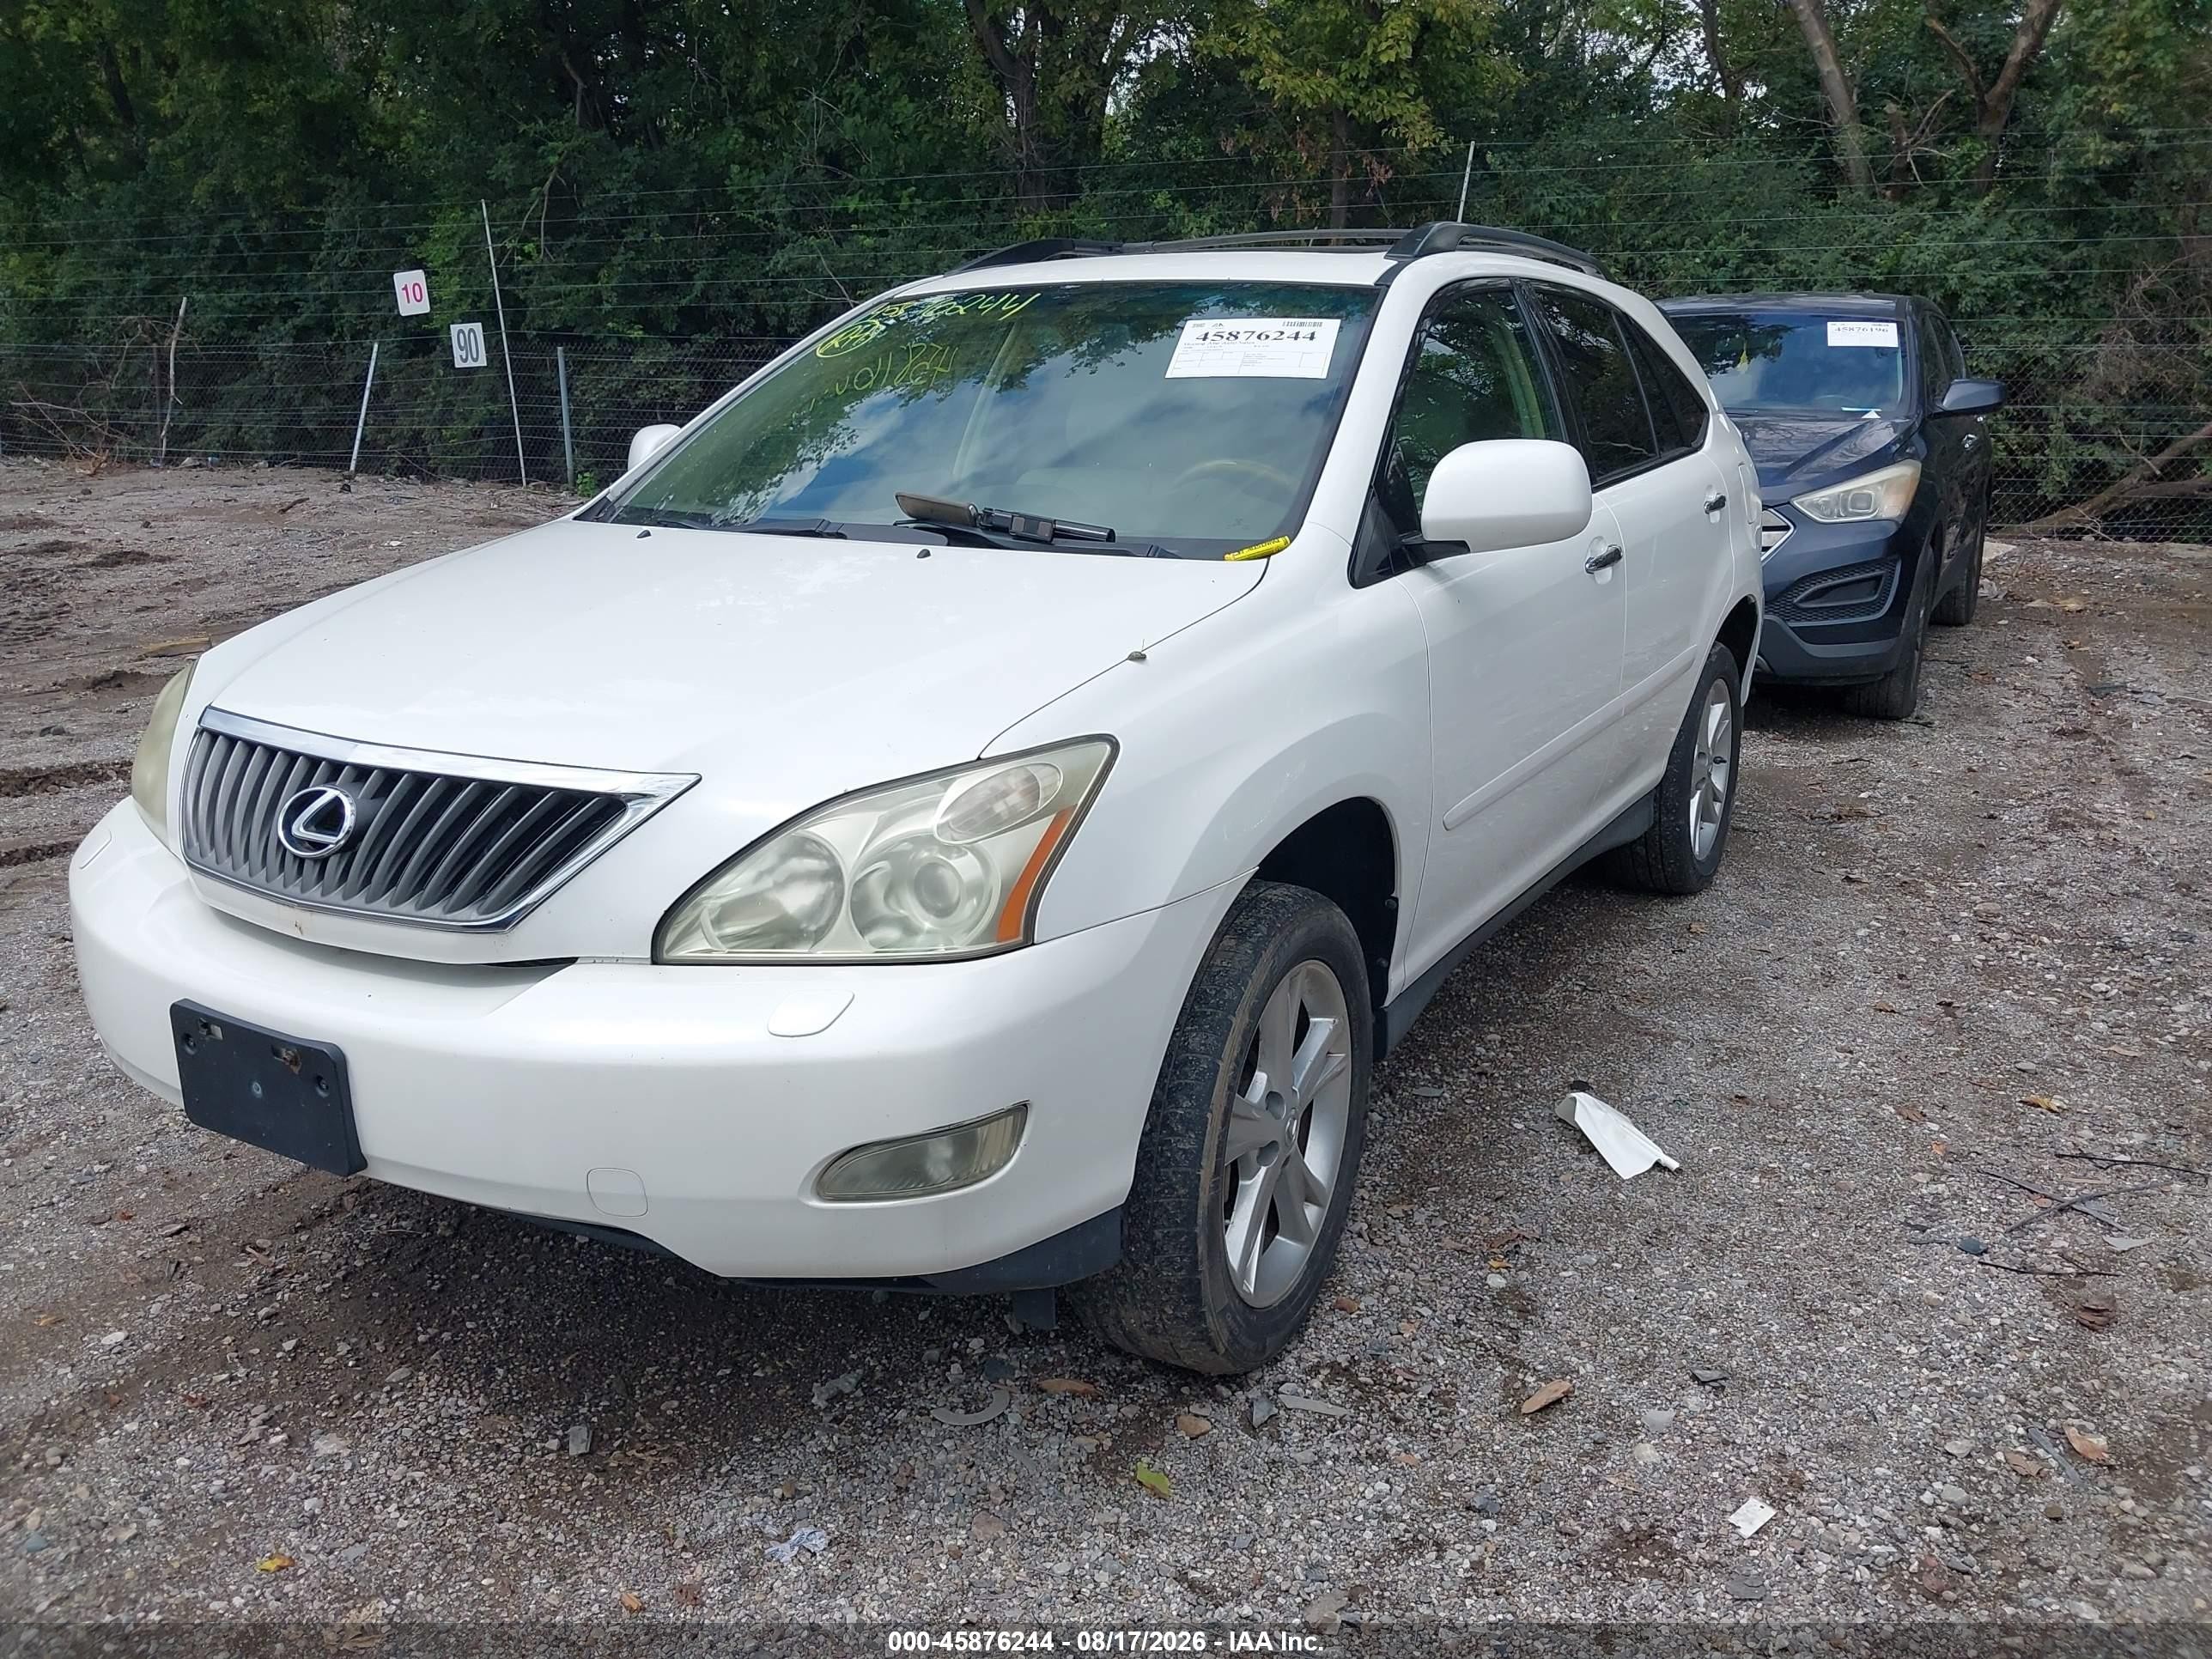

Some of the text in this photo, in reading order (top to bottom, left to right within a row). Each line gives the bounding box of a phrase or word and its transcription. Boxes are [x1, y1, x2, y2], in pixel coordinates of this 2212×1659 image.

[401, 282, 423, 304] 10
[457, 327, 480, 363] 90
[1194, 330, 1317, 342] 45876244
